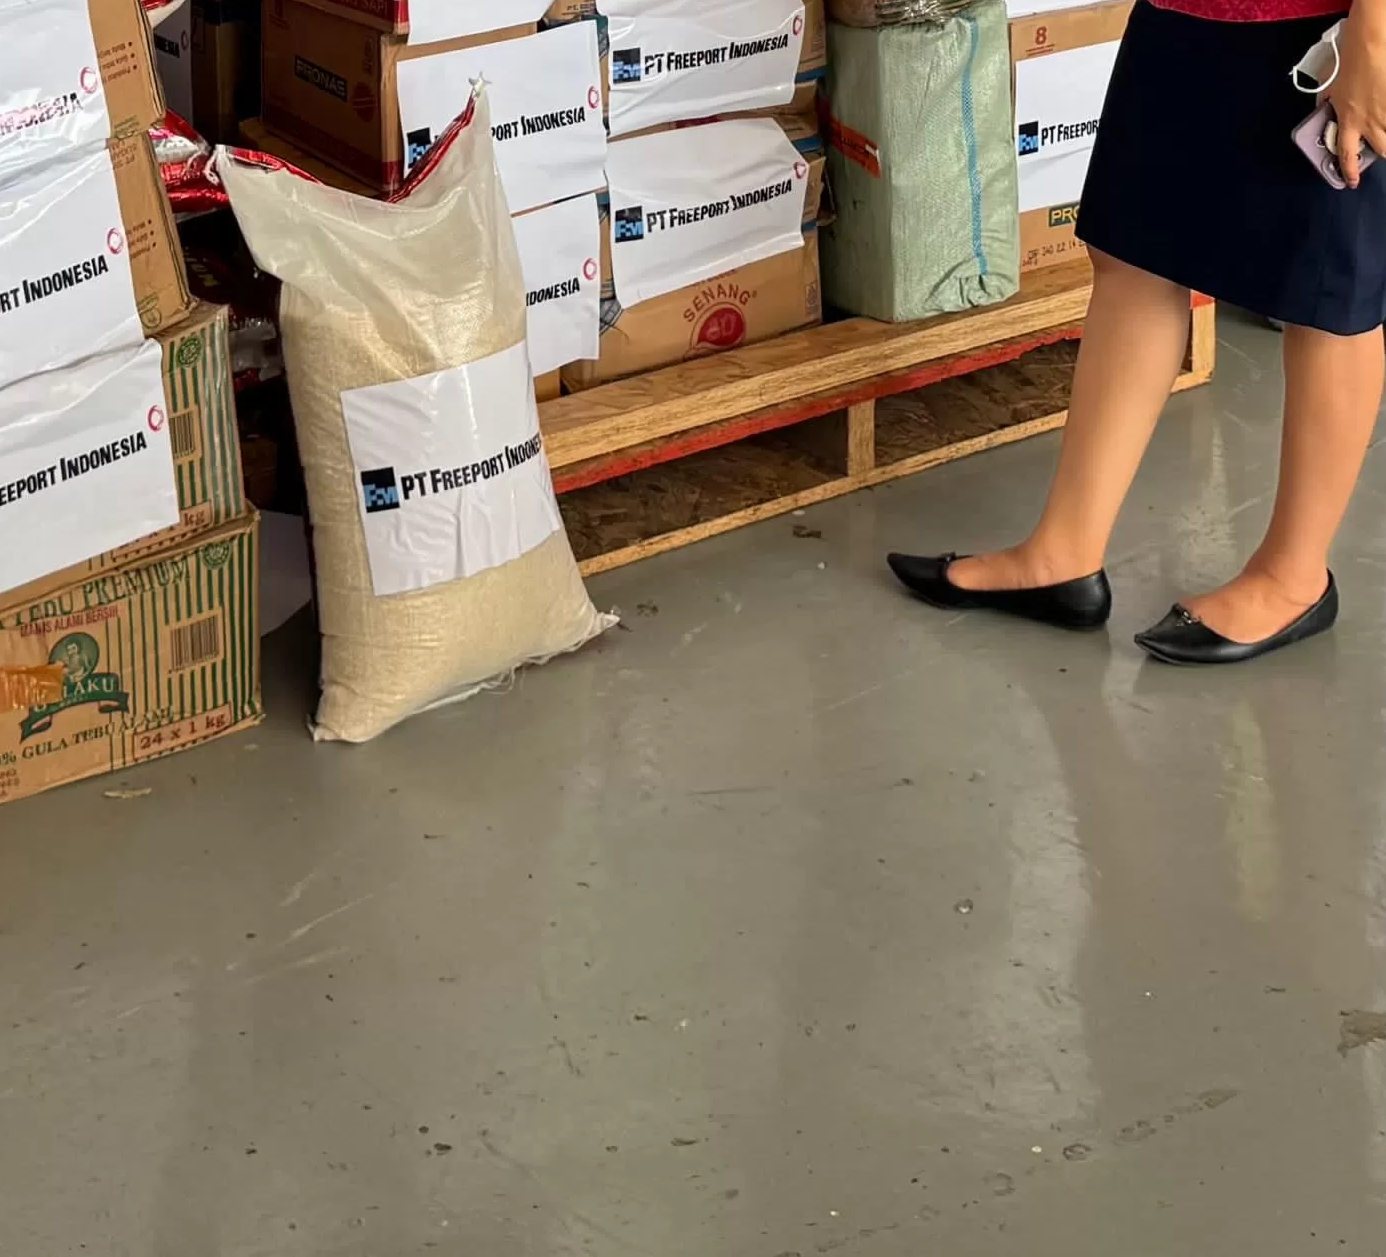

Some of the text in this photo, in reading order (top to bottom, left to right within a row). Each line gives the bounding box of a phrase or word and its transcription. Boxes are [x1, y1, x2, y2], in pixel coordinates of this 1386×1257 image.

[667, 47, 727, 72] FREEPORT
[729, 34, 788, 59] INDONESIA
[1035, 26, 1047, 44] 8
[521, 106, 585, 135] INDONESIA
[1041, 126, 1055, 146] PT
[646, 179, 792, 232] PT FREEPORT INDONESIA
[22, 254, 108, 304] INDONESIA
[683, 283, 750, 323] SENANG
[59, 432, 147, 482] INDONESIA
[401, 455, 504, 500] PT FREEPORT
[84, 561, 191, 609] PREMIUM
[54, 613, 84, 631] ALAMI
[86, 606, 119, 625] BERSIH
[22, 738, 68, 760] GULA
[141, 733, 162, 752] 24
[189, 723, 197, 736] 1
[206, 714, 226, 734] kg
